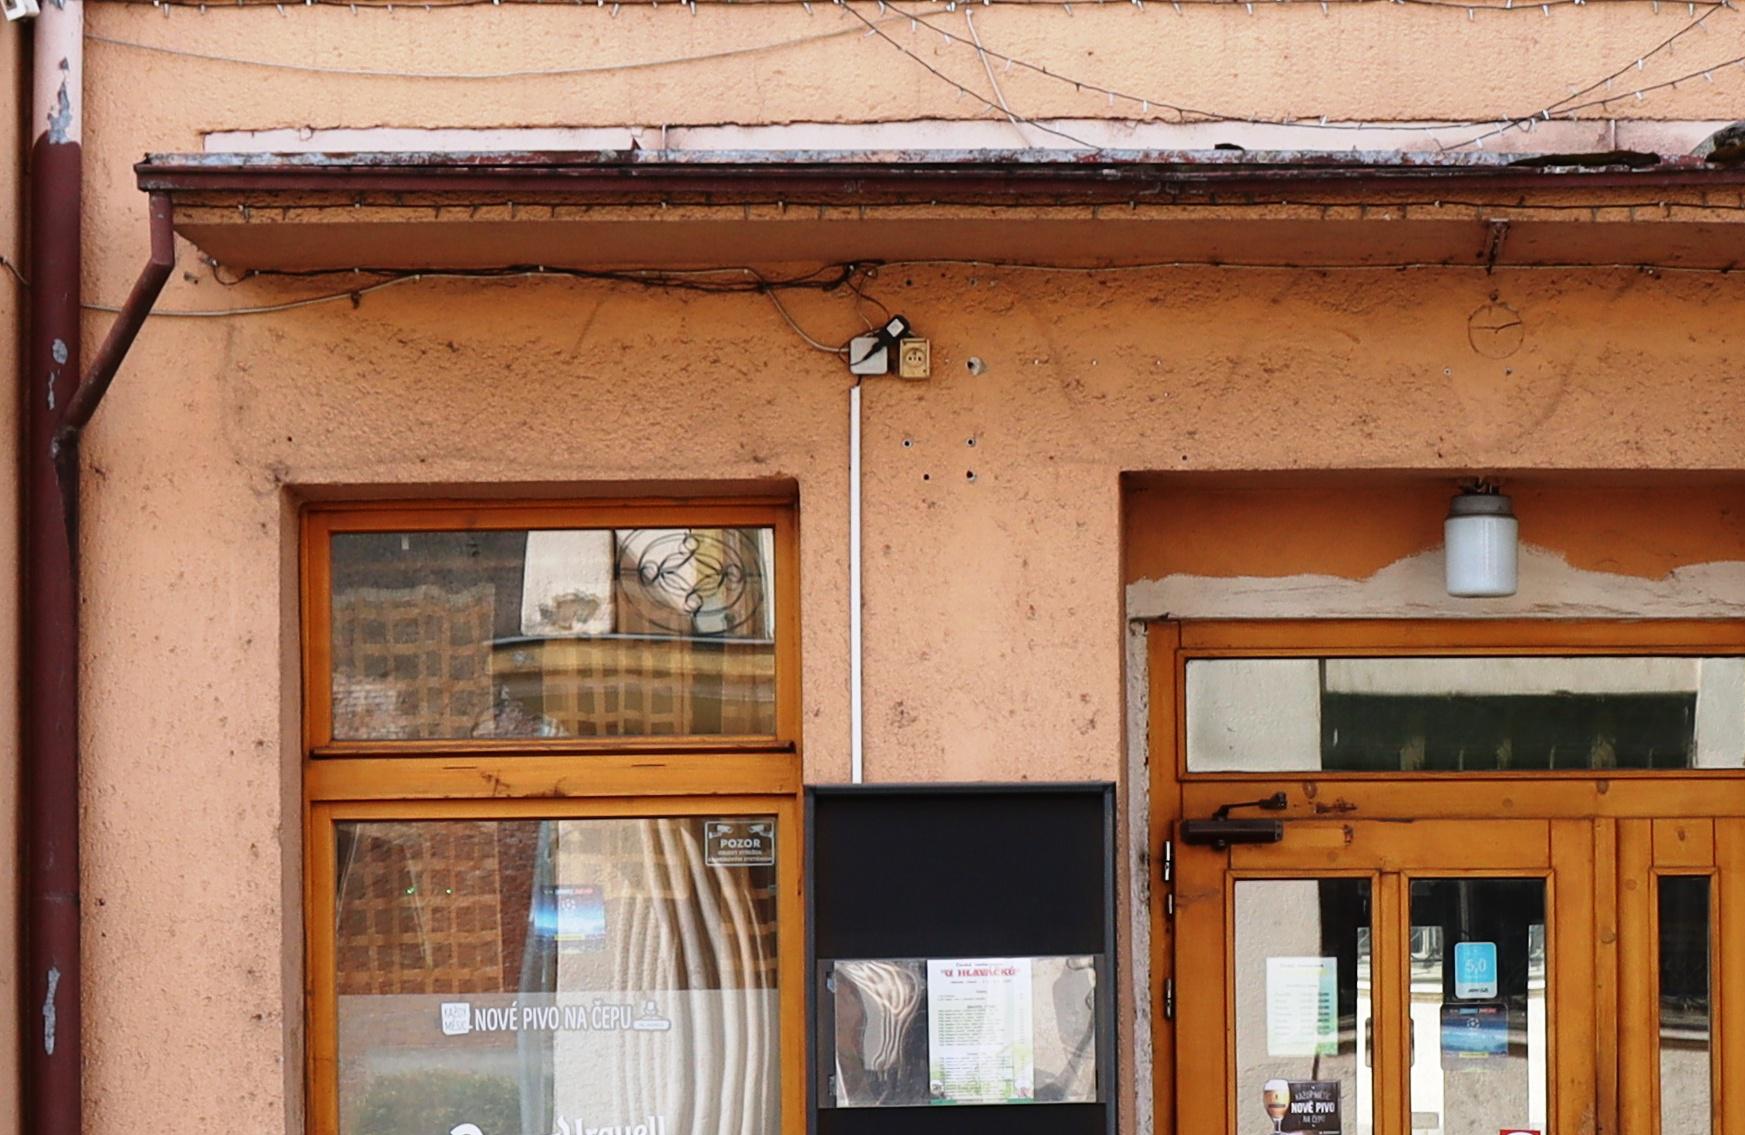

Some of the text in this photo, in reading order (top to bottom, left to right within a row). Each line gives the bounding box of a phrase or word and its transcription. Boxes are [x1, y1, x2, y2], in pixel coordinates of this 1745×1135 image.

[720, 839, 761, 849] POZOR
[475, 1000, 632, 1031] NOVÉ PIVO NA ČEPU
[1291, 1101, 1335, 1113] NOVÉ PIVO
